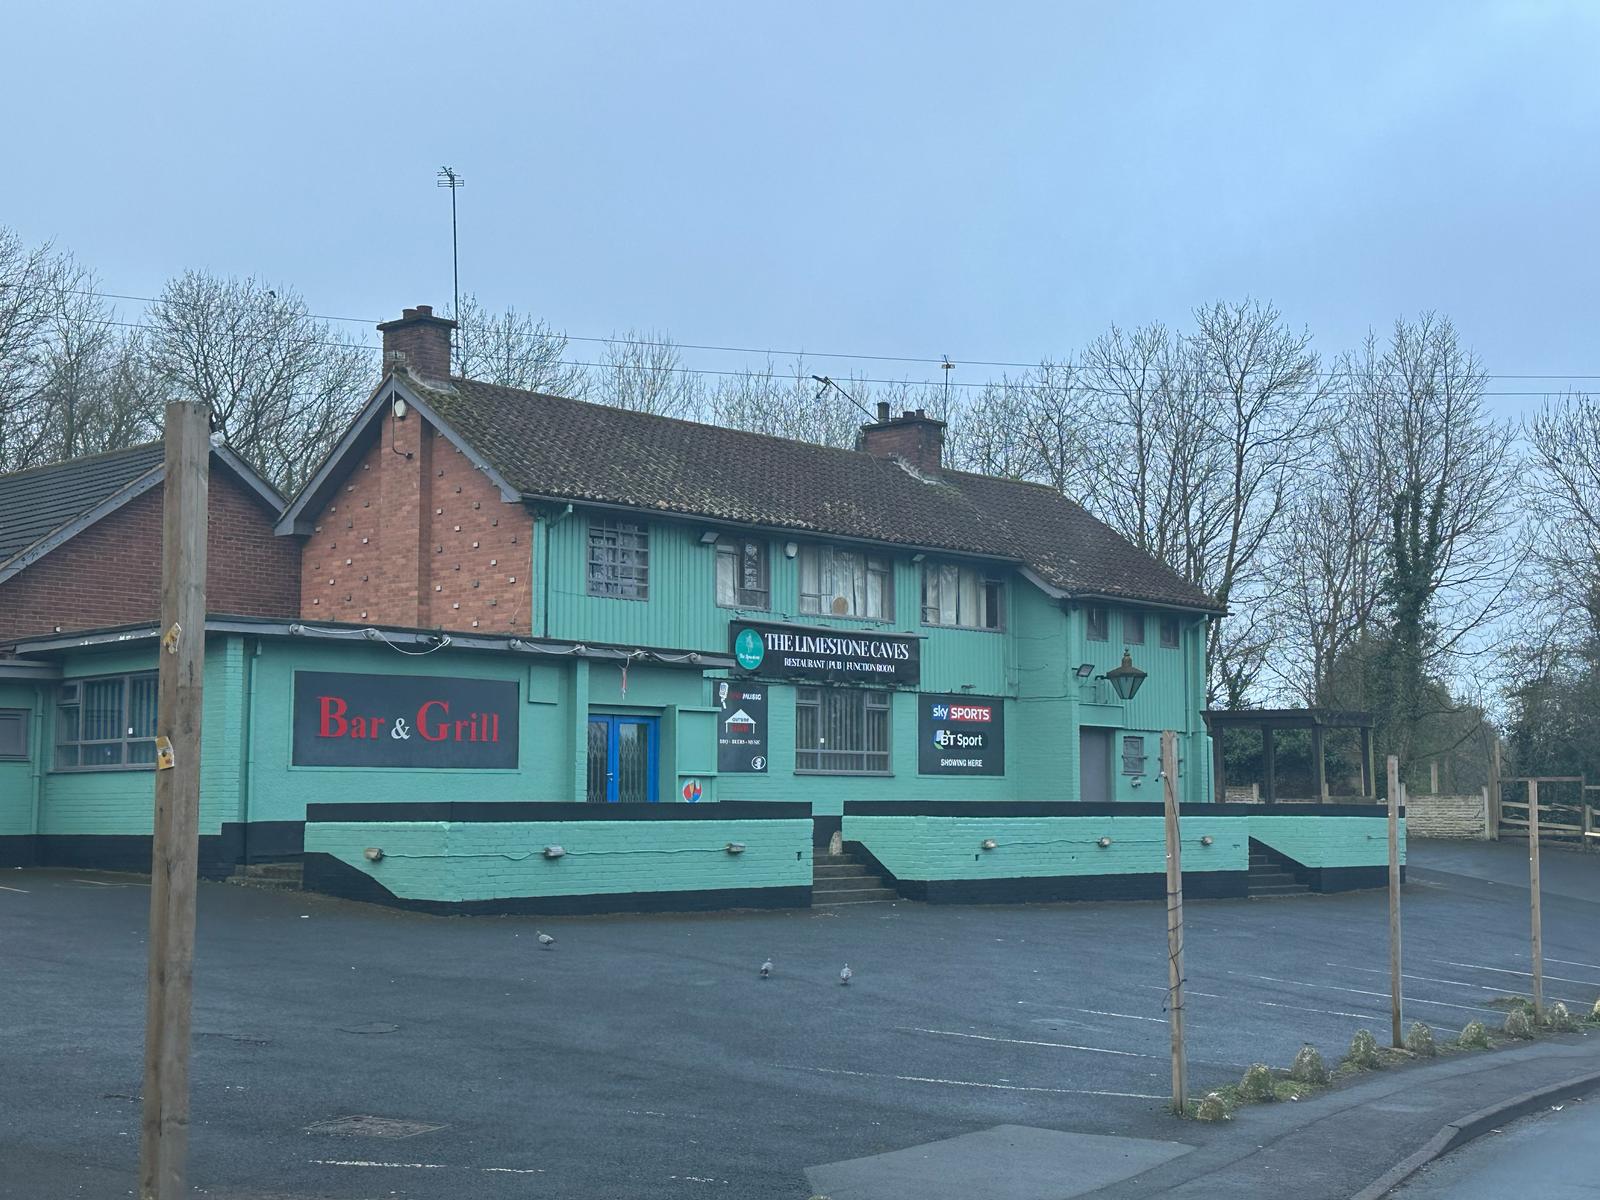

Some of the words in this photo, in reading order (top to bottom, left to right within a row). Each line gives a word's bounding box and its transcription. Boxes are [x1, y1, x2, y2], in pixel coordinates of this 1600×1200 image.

[765, 633, 793, 651] THE
[795, 635, 870, 657] LIMESTONE
[870, 641, 909, 660] CAVES
[784, 657, 825, 669] RESTAURANT
[829, 660, 842, 670] PUB
[846, 661, 876, 672] FUNCTION
[876, 663, 895, 673] ROOM
[742, 693, 762, 701] MUSIC
[316, 696, 385, 740] Bar
[390, 717, 410, 740] &
[416, 700, 500, 742] Grill
[933, 704, 949, 719] sky
[950, 707, 990, 721] SPORTS
[940, 734, 956, 746] BT
[956, 733, 983, 749] Sport
[940, 758, 967, 767] SHOWING
[967, 759, 983, 768] HERE
